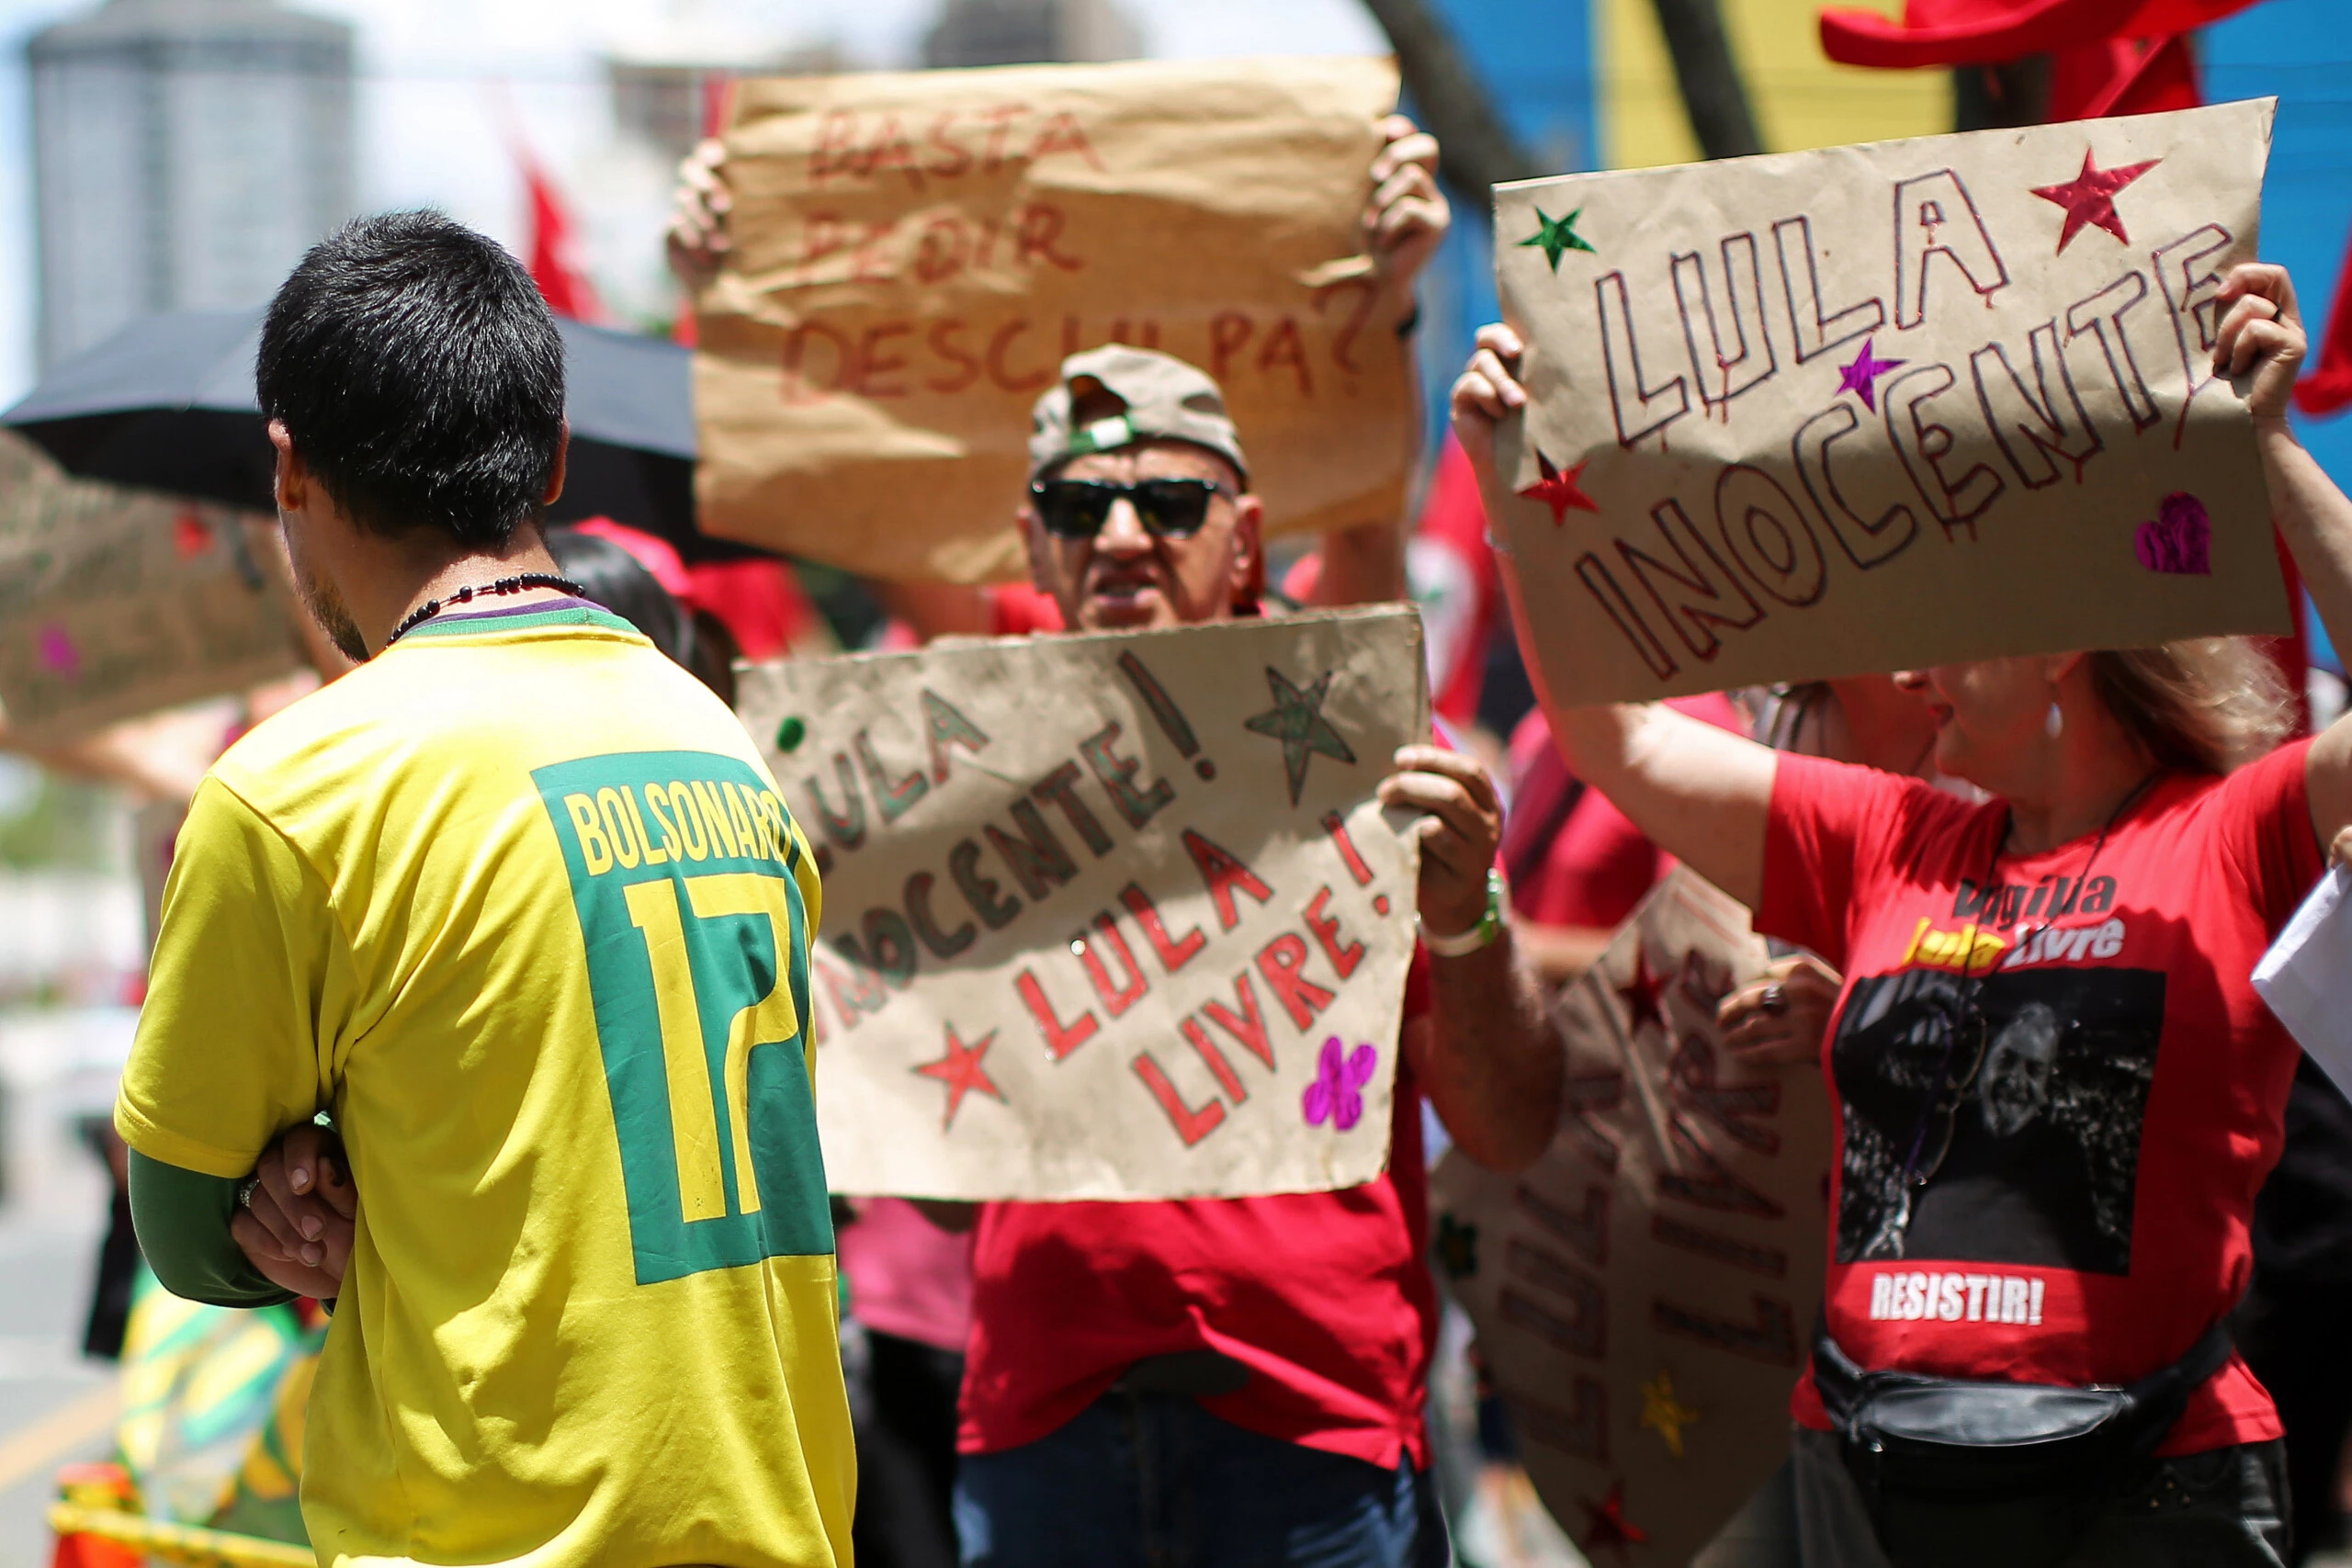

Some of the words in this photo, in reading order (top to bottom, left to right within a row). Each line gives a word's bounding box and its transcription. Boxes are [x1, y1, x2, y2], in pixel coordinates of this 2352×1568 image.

[797, 201, 1085, 292] PEDIR
[808, 103, 1108, 194] BASTA
[1595, 168, 2010, 450] LULA
[815, 687, 990, 880] ULA
[623, 873, 798, 1224] 17
[1014, 829, 1274, 1064] LULA
[1131, 810, 1390, 1146] LIVRE!
[1870, 1270, 2046, 1326] RESISTIR!
